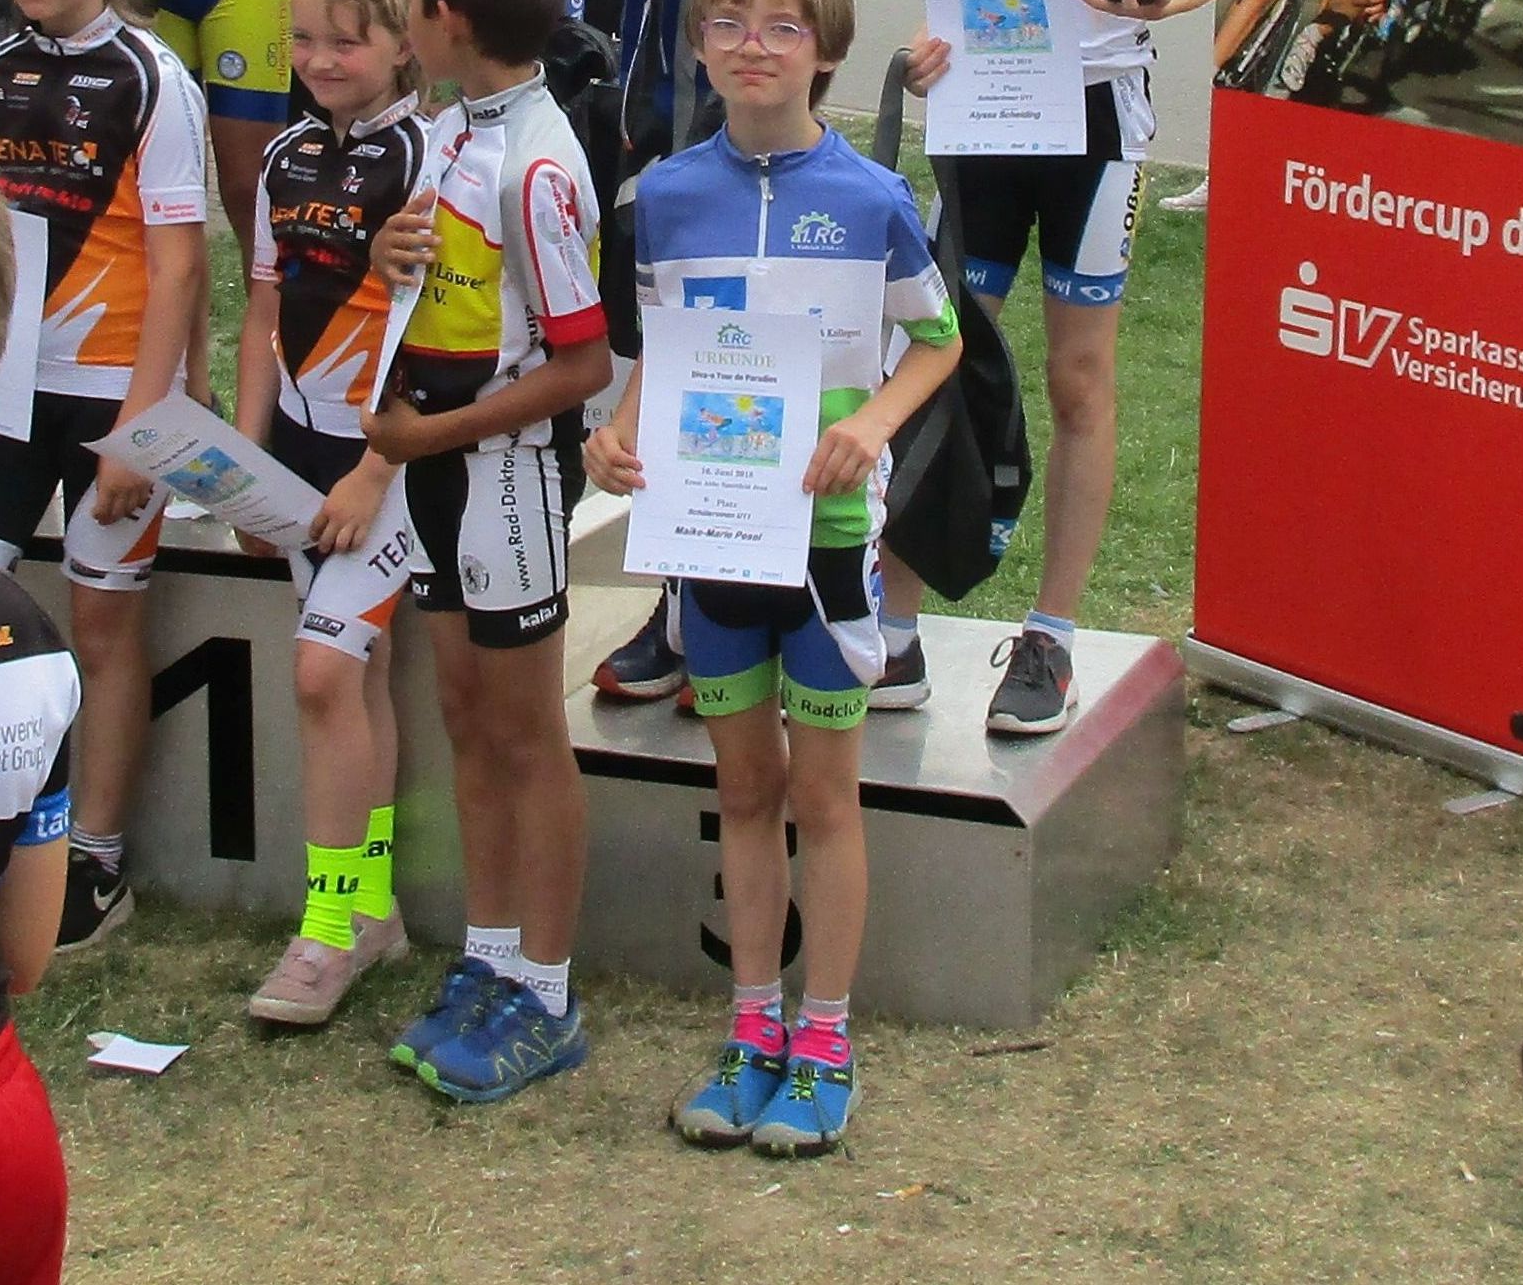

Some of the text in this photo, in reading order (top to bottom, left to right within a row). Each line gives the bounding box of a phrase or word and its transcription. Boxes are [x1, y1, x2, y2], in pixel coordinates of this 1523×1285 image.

[1283, 159, 1490, 257] Fördercup
[694, 349, 777, 369] URKUNDE
[150, 636, 256, 862] 1
